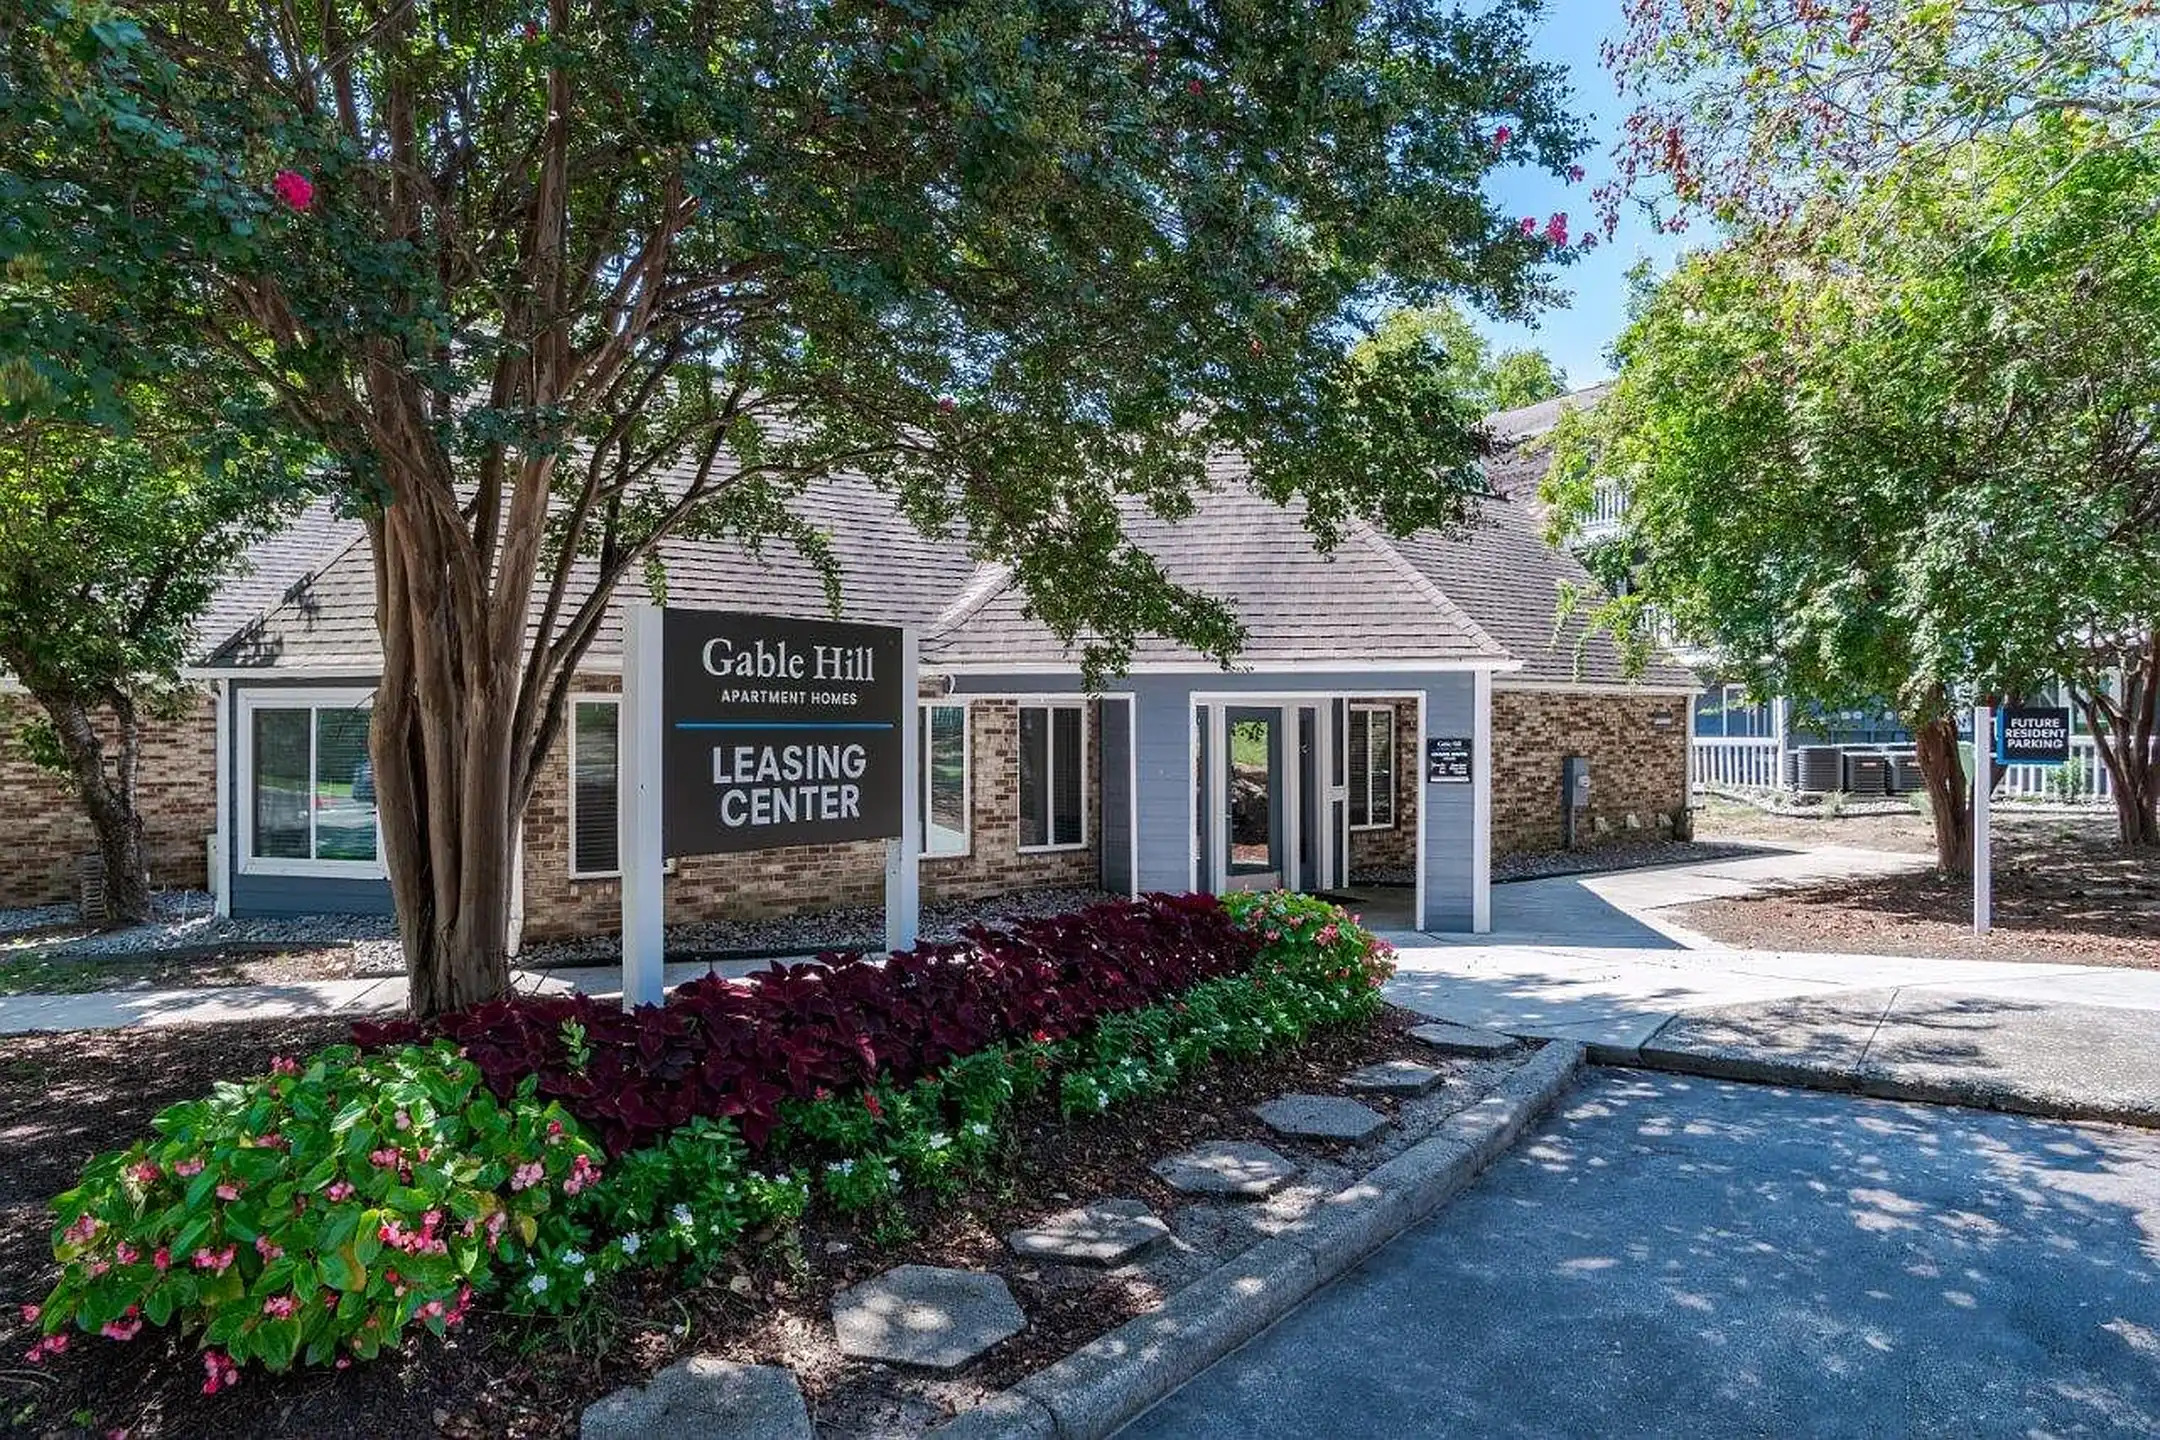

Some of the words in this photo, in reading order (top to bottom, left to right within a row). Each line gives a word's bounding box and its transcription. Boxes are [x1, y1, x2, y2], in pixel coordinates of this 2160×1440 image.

[702, 637, 804, 680] Gable
[813, 645, 875, 682] Hill
[721, 689, 806, 704] APARTMENT
[811, 692, 858, 706] HOMES
[2011, 718, 2060, 728] FUTURE
[2005, 728, 2066, 738] RESIDENT
[2007, 738, 2064, 748] PARKING
[712, 743, 867, 784] LEASING
[721, 784, 861, 828] CENTER
